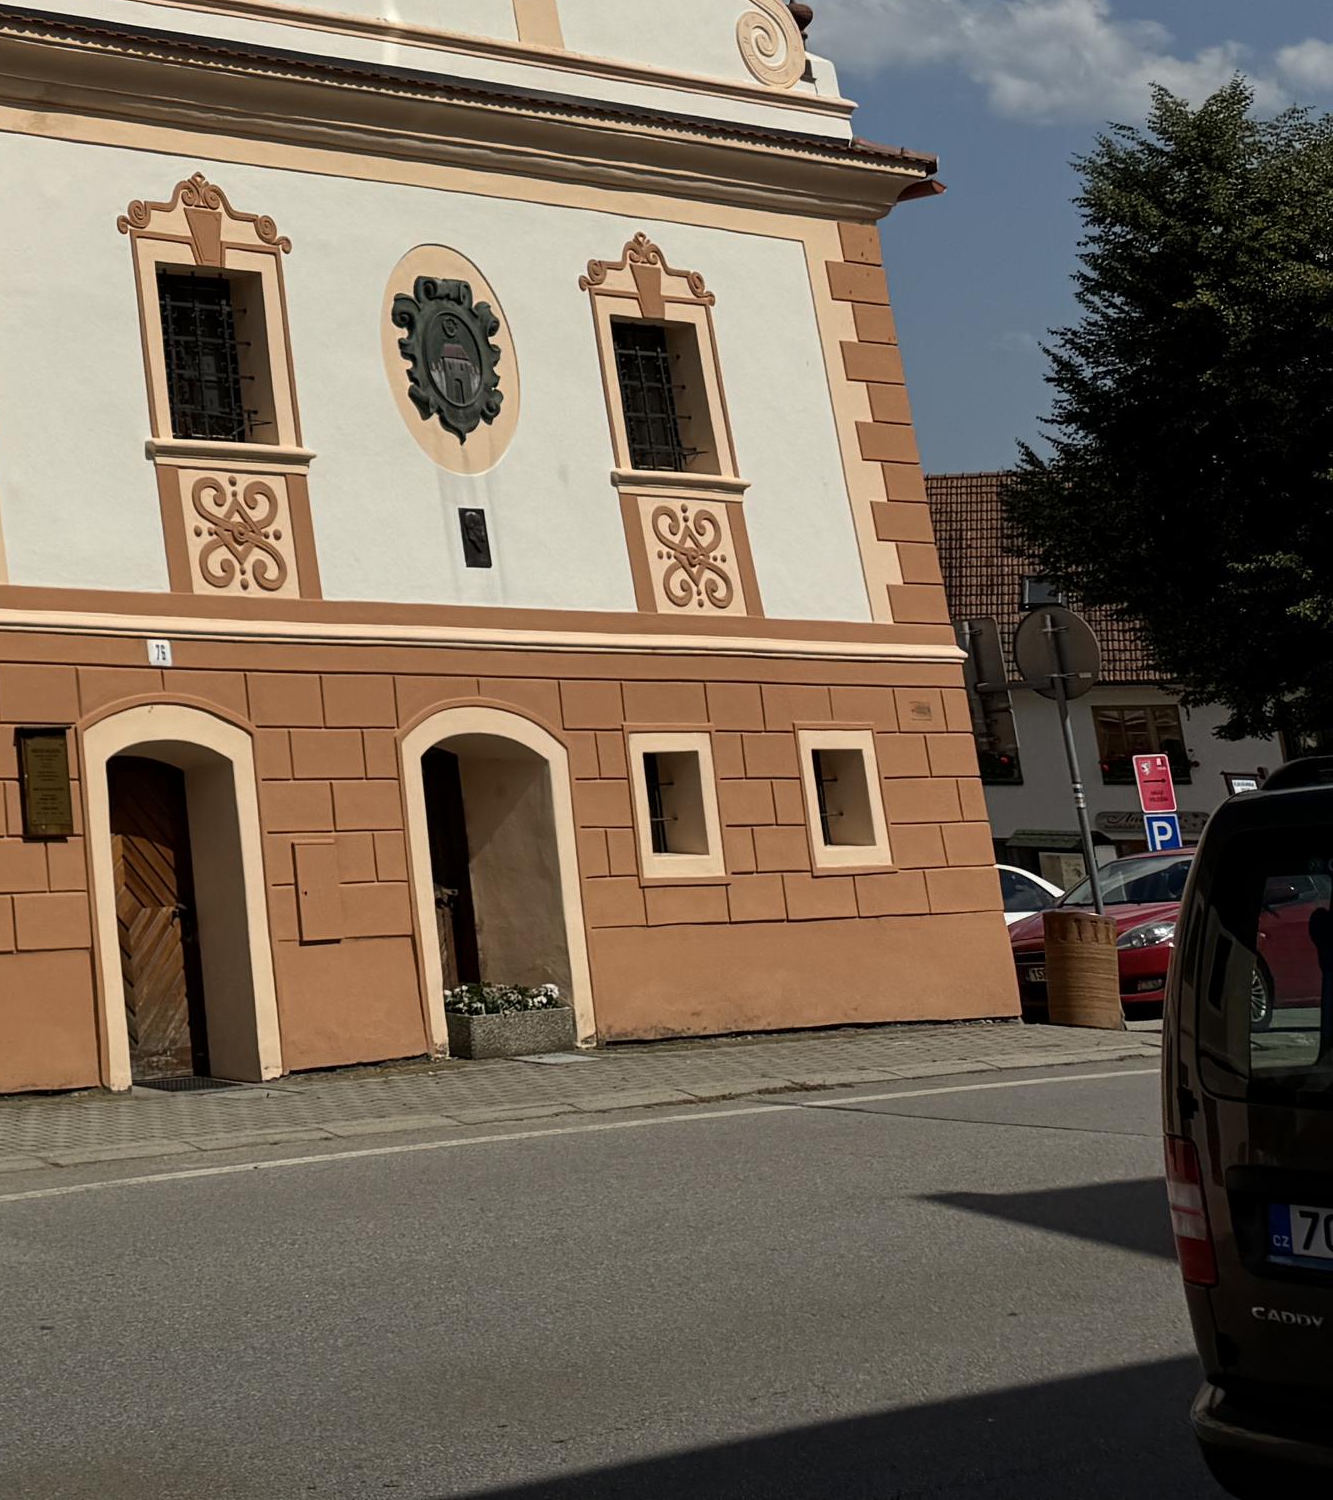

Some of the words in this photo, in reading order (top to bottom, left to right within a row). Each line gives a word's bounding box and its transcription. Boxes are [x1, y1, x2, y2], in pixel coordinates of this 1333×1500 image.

[1152, 821, 1173, 851] P
[1273, 1234, 1290, 1247] CZ
[1251, 1306, 1324, 1327] CADDY
